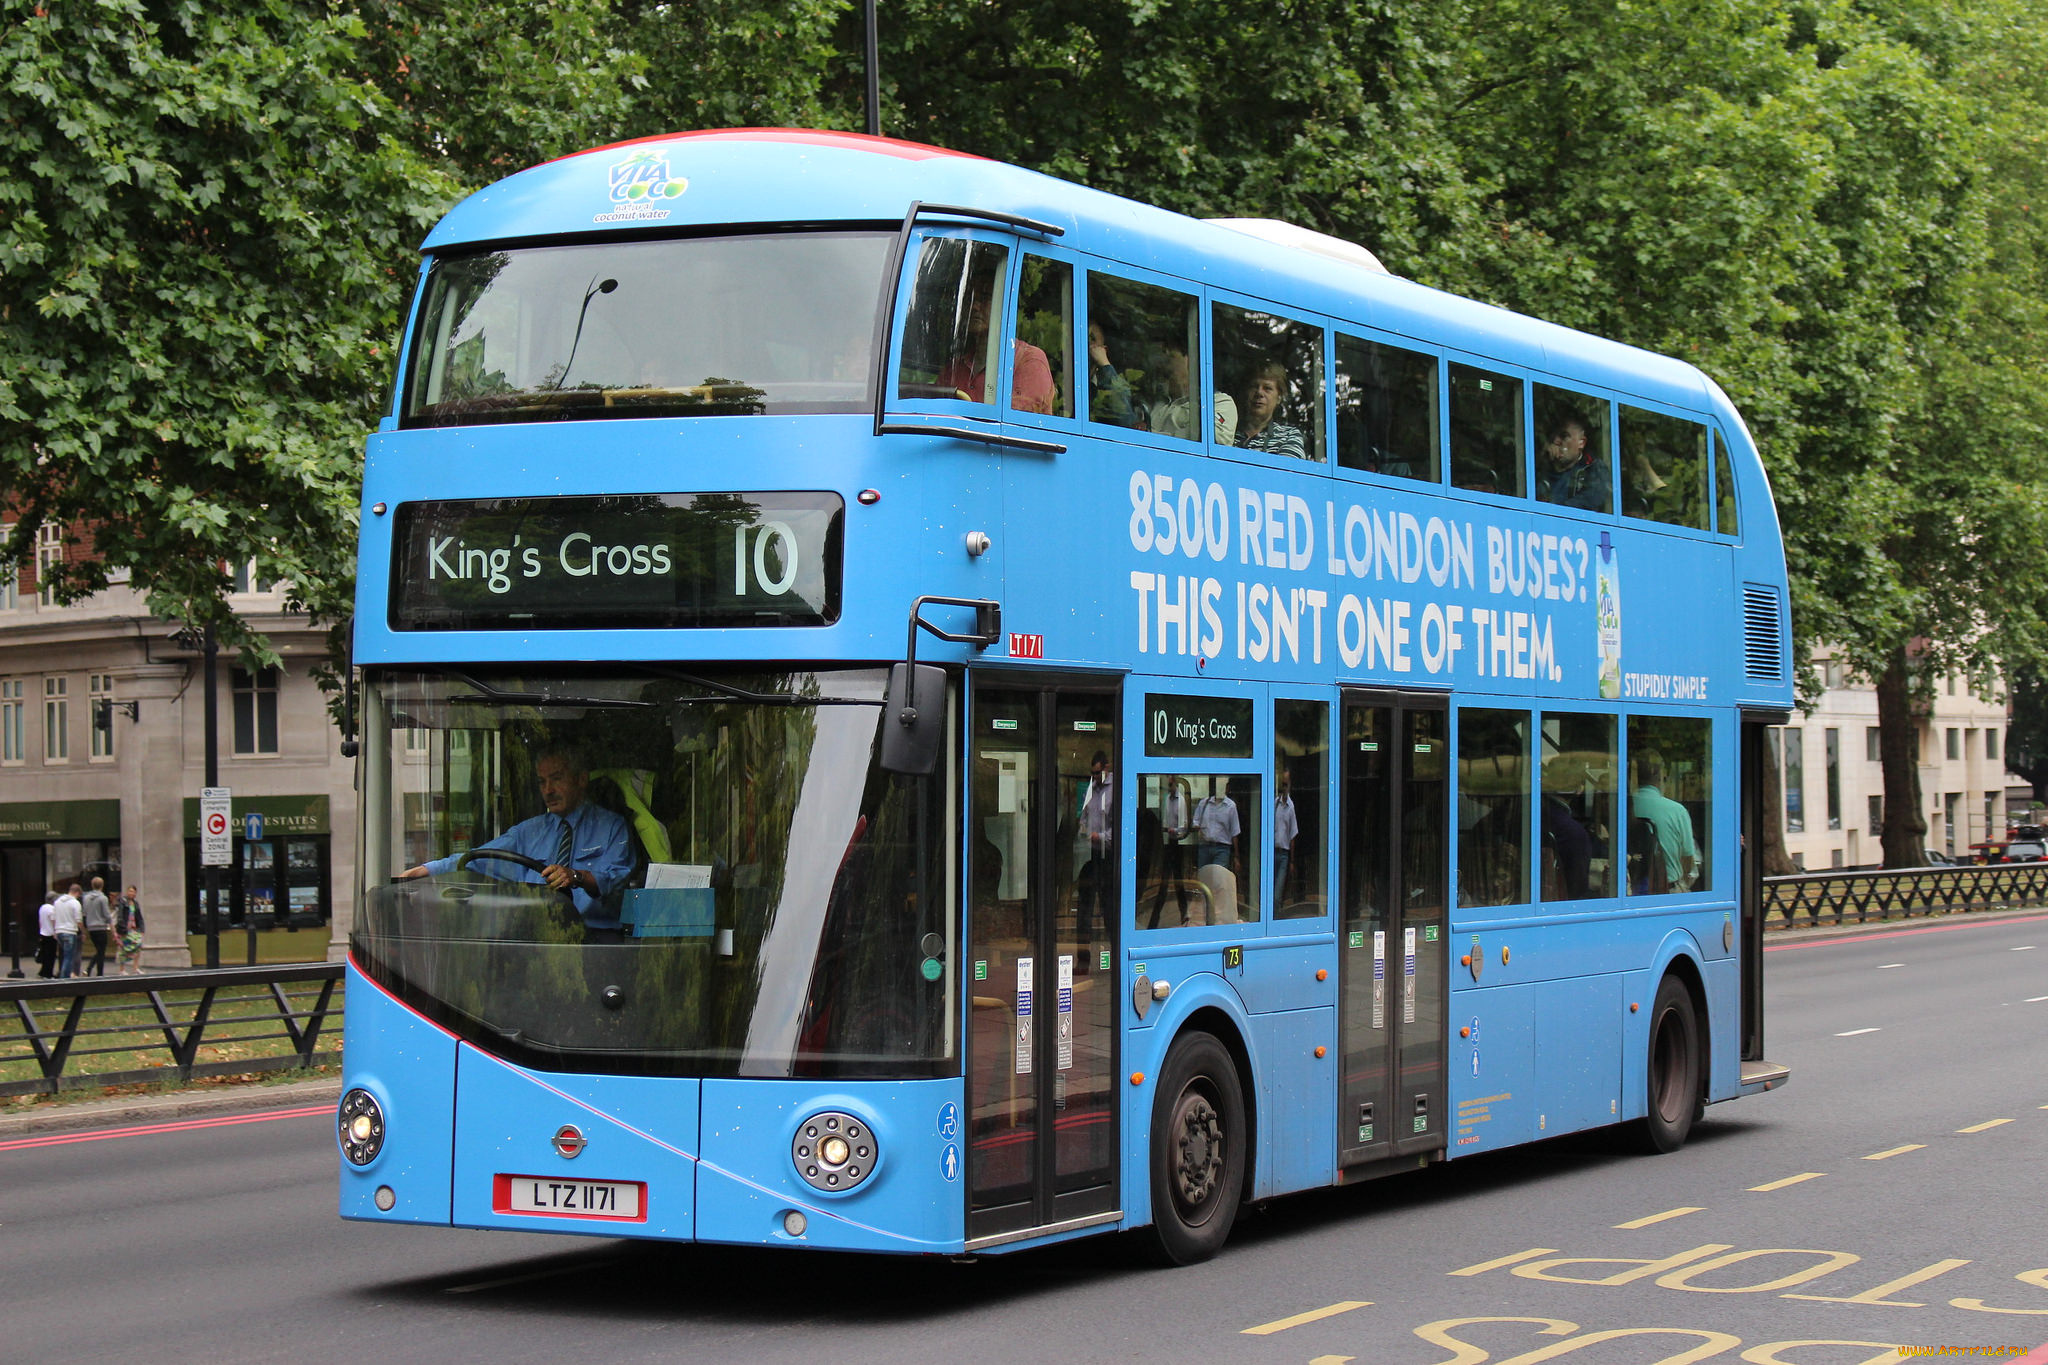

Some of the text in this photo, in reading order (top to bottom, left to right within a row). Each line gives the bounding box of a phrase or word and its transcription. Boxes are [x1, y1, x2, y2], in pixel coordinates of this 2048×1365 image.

[594, 209, 669, 222] coconut water
[1129, 470, 1589, 603] 8500 RED LONDON BUSES?
[428, 520, 799, 596] King's Cross 10
[1130, 570, 1562, 683] THIS ISN'T ONE OF THEM.
[1009, 633, 1042, 657] LT171
[1624, 673, 1708, 700] STUPIDLY SIMPLE
[1153, 710, 1237, 746] 10 King's Cross
[264, 815, 317, 826] ESTATES
[1229, 948, 1240, 966] 73
[533, 1182, 616, 1211] LTZ 1171
